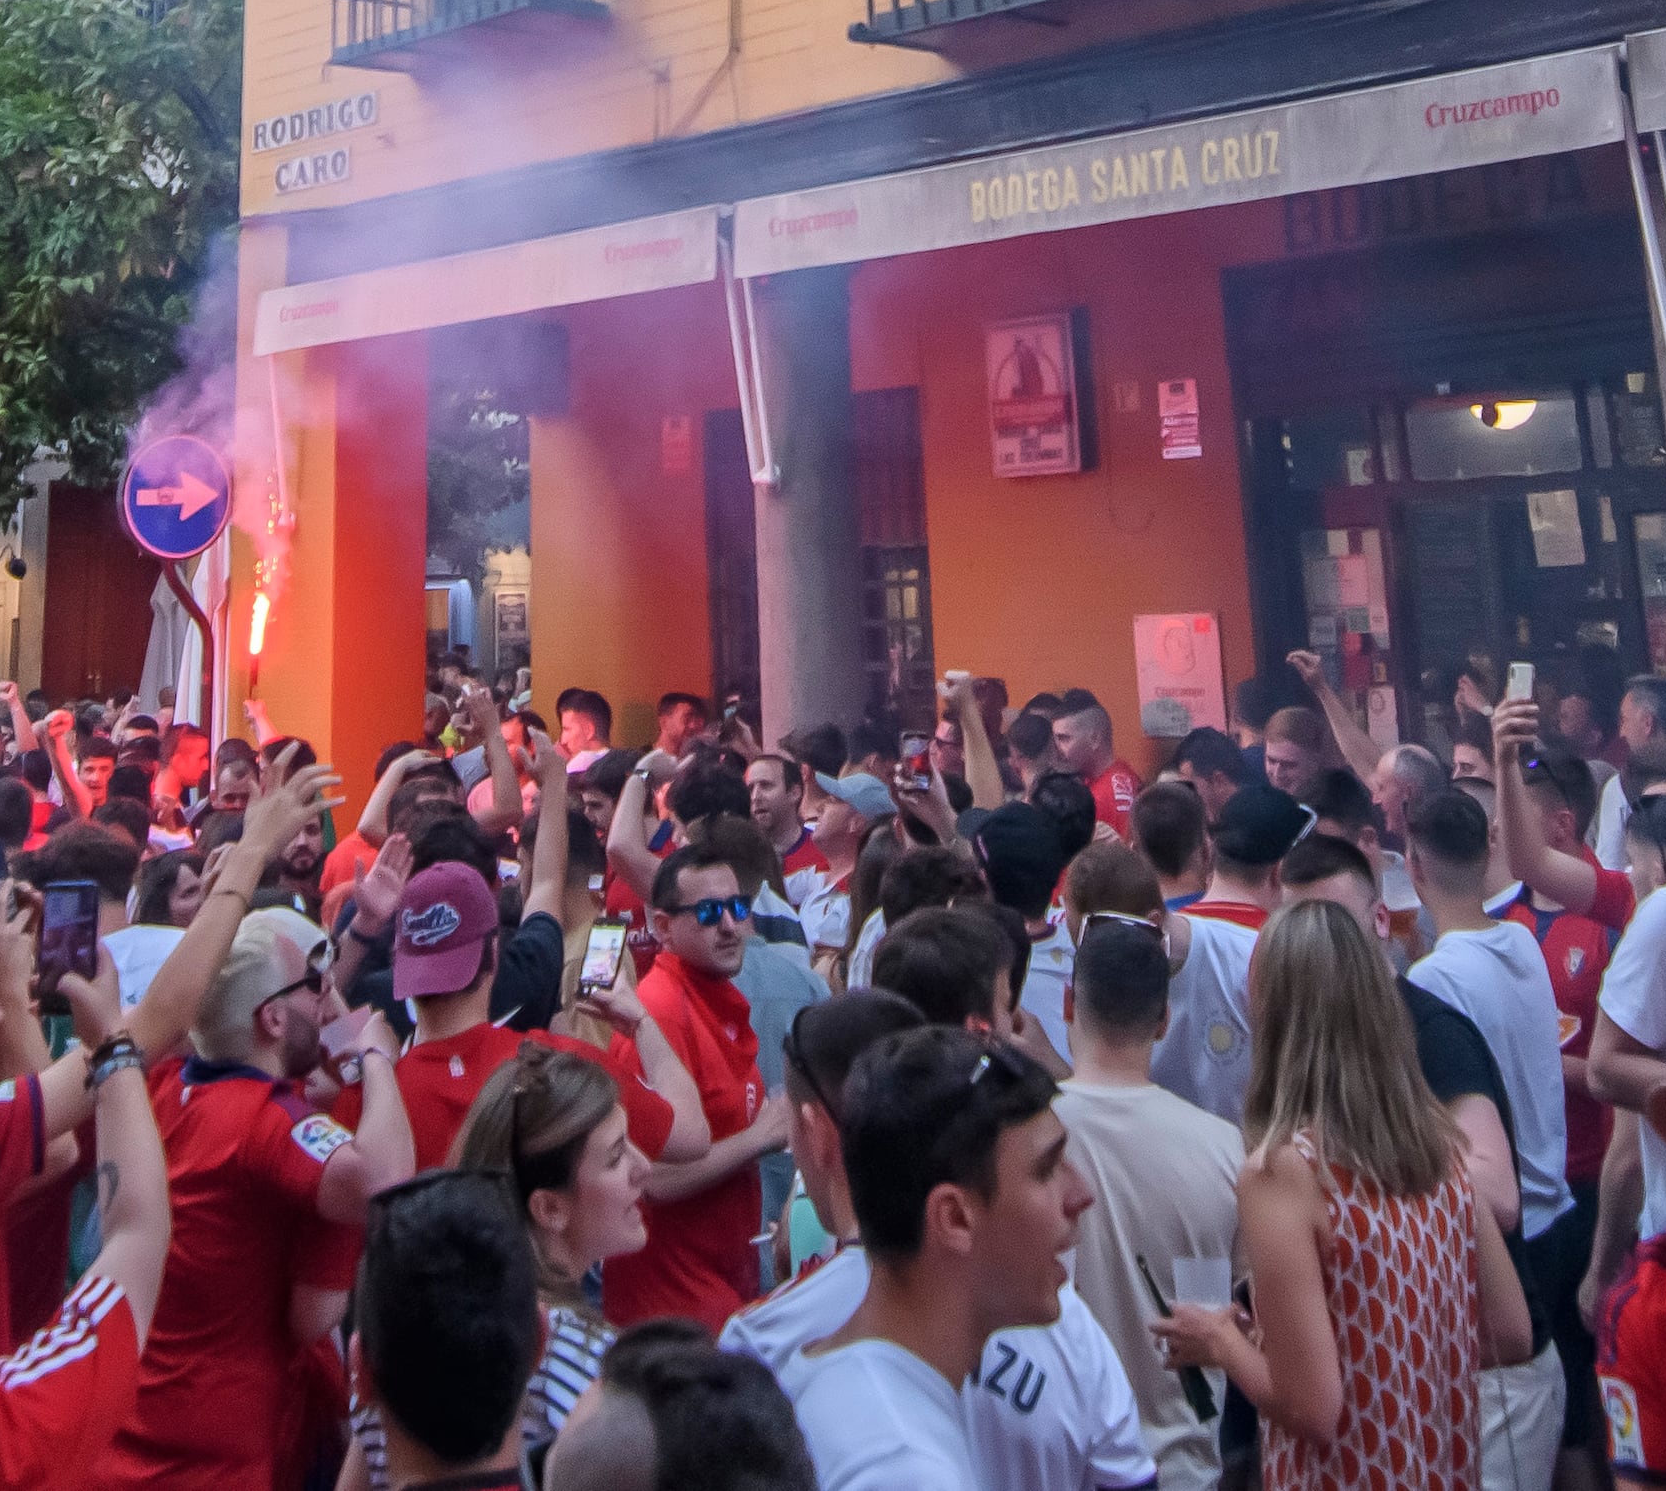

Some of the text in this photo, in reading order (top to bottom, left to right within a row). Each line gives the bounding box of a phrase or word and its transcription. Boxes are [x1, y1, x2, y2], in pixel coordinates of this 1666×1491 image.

[1423, 87, 1561, 128] Cruzcampo
[275, 150, 347, 192] CARO
[971, 130, 1281, 223] BODEGA SANTA CRUZ
[768, 203, 859, 238] Cruzcampo
[983, 1340, 1047, 1415] ZU
